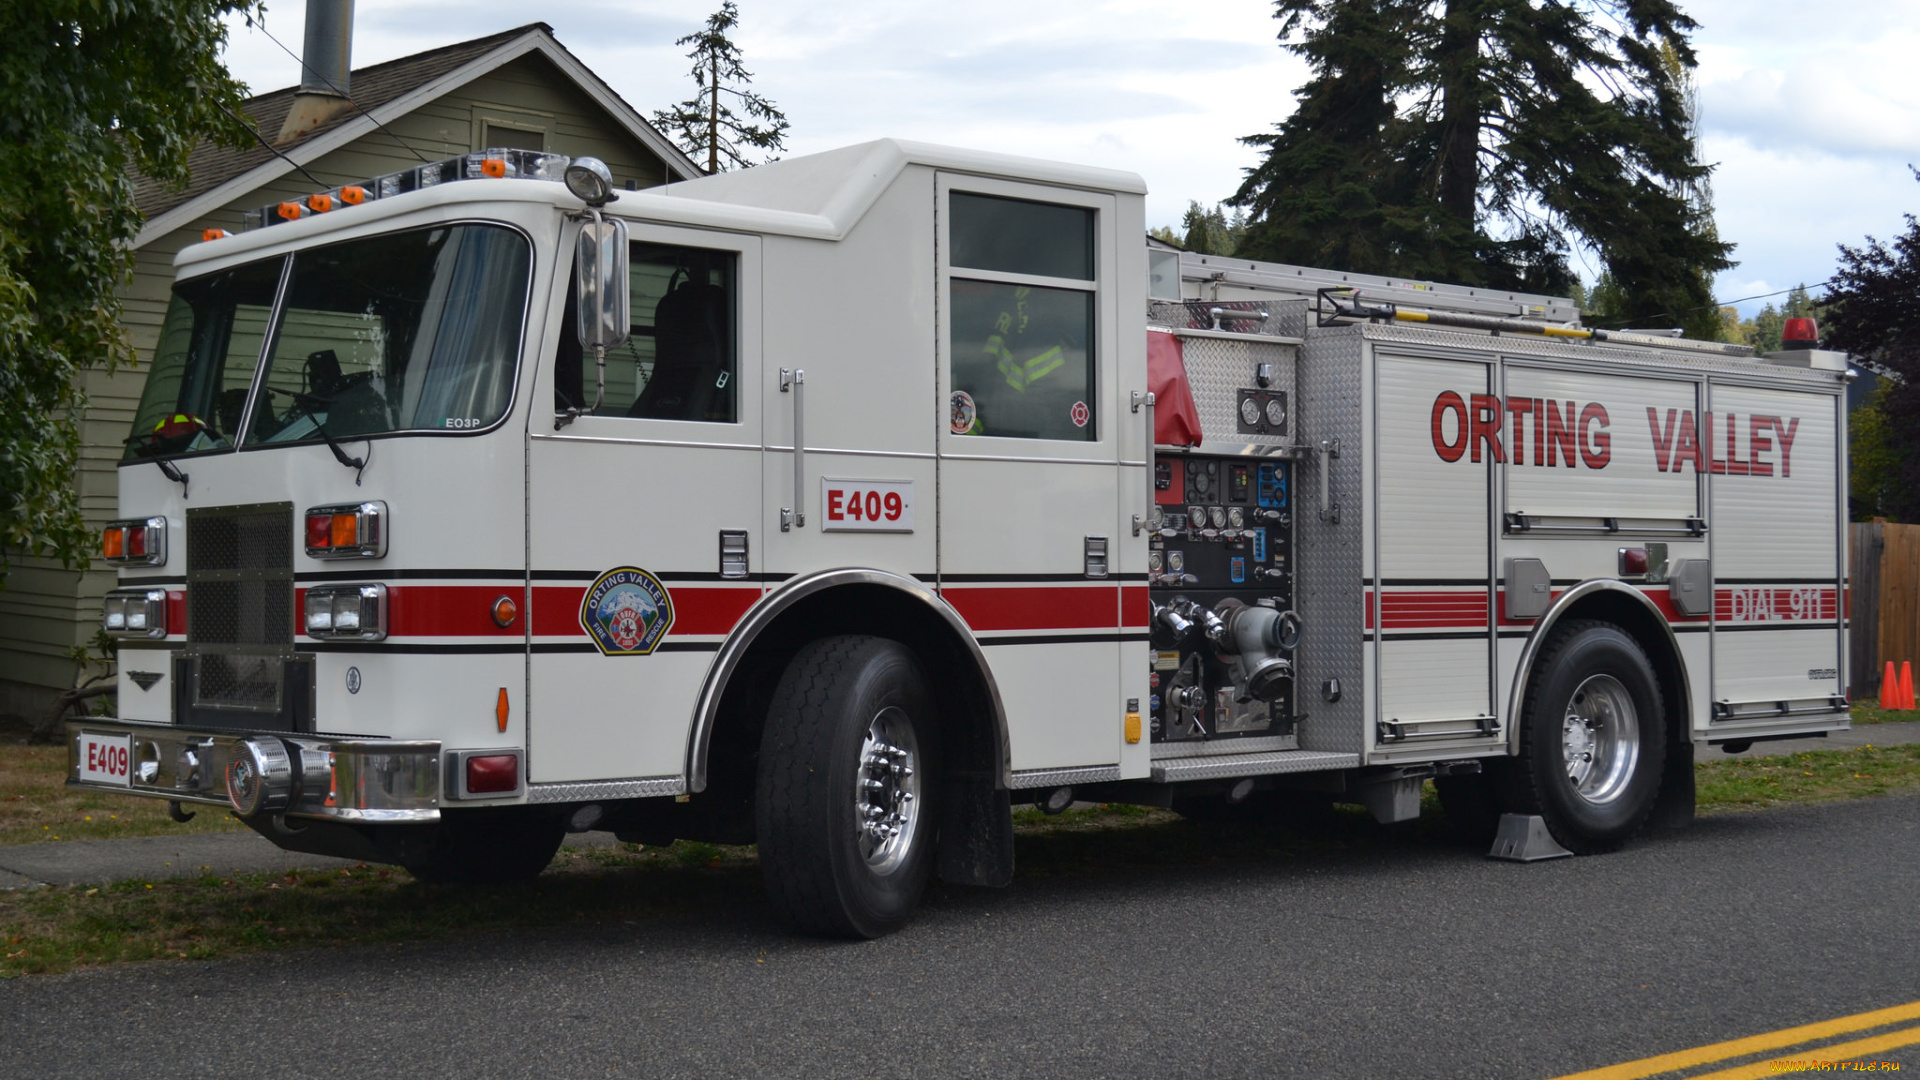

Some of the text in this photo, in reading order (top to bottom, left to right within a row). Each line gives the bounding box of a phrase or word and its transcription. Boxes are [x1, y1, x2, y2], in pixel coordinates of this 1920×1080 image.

[1431, 390, 1800, 478] ORTING VALLEY
[828, 489, 902, 521] E409
[589, 572, 666, 609] ORTING VALLEY
[1731, 588, 1821, 620] DIAL 911
[592, 622, 607, 640] FIRE
[645, 617, 665, 644] RESCUE
[88, 742, 128, 776] E409
